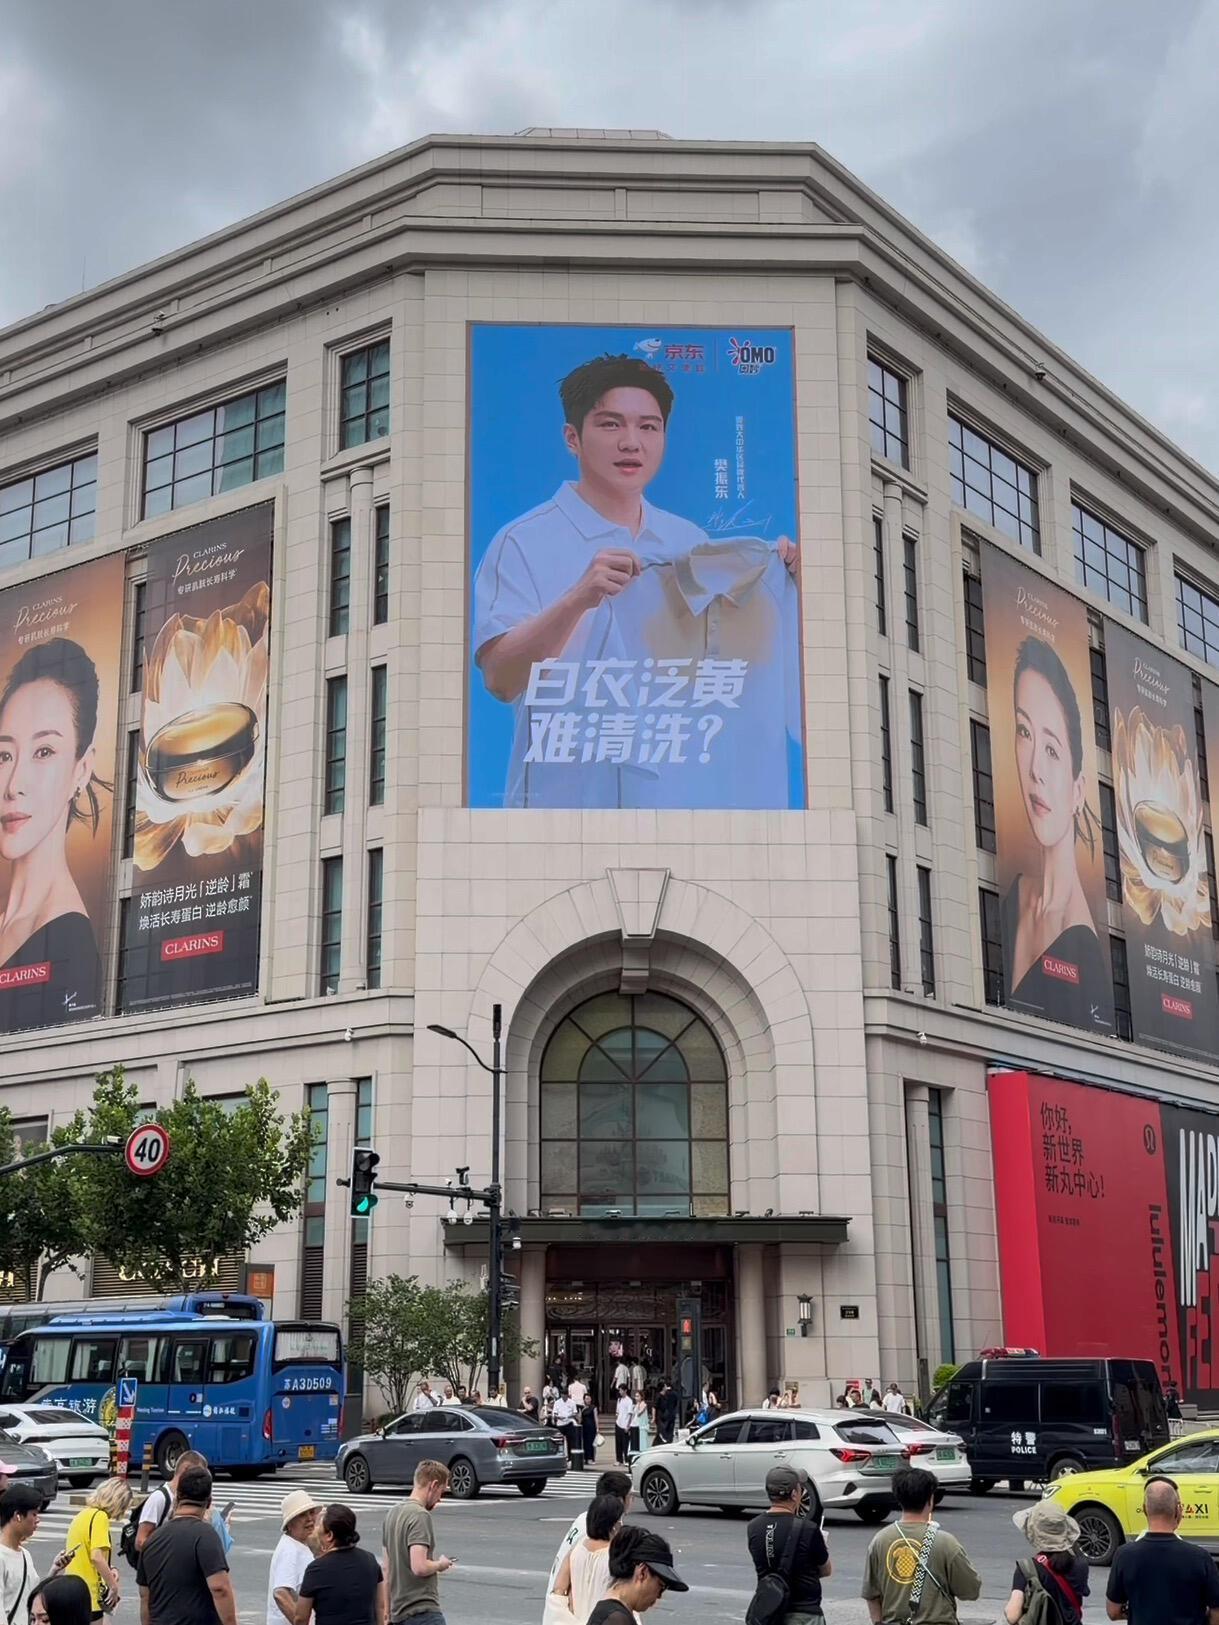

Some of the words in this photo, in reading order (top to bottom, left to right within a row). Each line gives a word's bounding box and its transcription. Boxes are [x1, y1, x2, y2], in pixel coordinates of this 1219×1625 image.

[664, 344, 705, 360] 京东
[740, 346, 775, 364] OMO
[714, 458, 729, 499] 樊振东
[193, 542, 227, 559] CLARINS
[171, 549, 245, 587] Precious
[13, 603, 78, 635] Precious
[524, 657, 749, 709] 白衣泛黄
[523, 711, 723, 764] 难清洗？
[139, 905, 202, 930] 焕活长寿蛋白
[205, 895, 251, 918] 逆龄愈颜
[165, 935, 218, 955] CLARINS
[0, 966, 47, 984] CLARINS
[1044, 959, 1077, 978] CLARINS
[1163, 998, 1191, 1014] CLARINS
[1040, 1101, 1072, 1135] 你好，
[134, 1137, 161, 1163] 40
[1042, 1132, 1084, 1166] 新世界
[1044, 1163, 1105, 1199] 新丸中心！
[1011, 1431, 1036, 1445] 特警
[1011, 1446, 1037, 1455] POLICE
[1179, 1503, 1209, 1515] AXI
